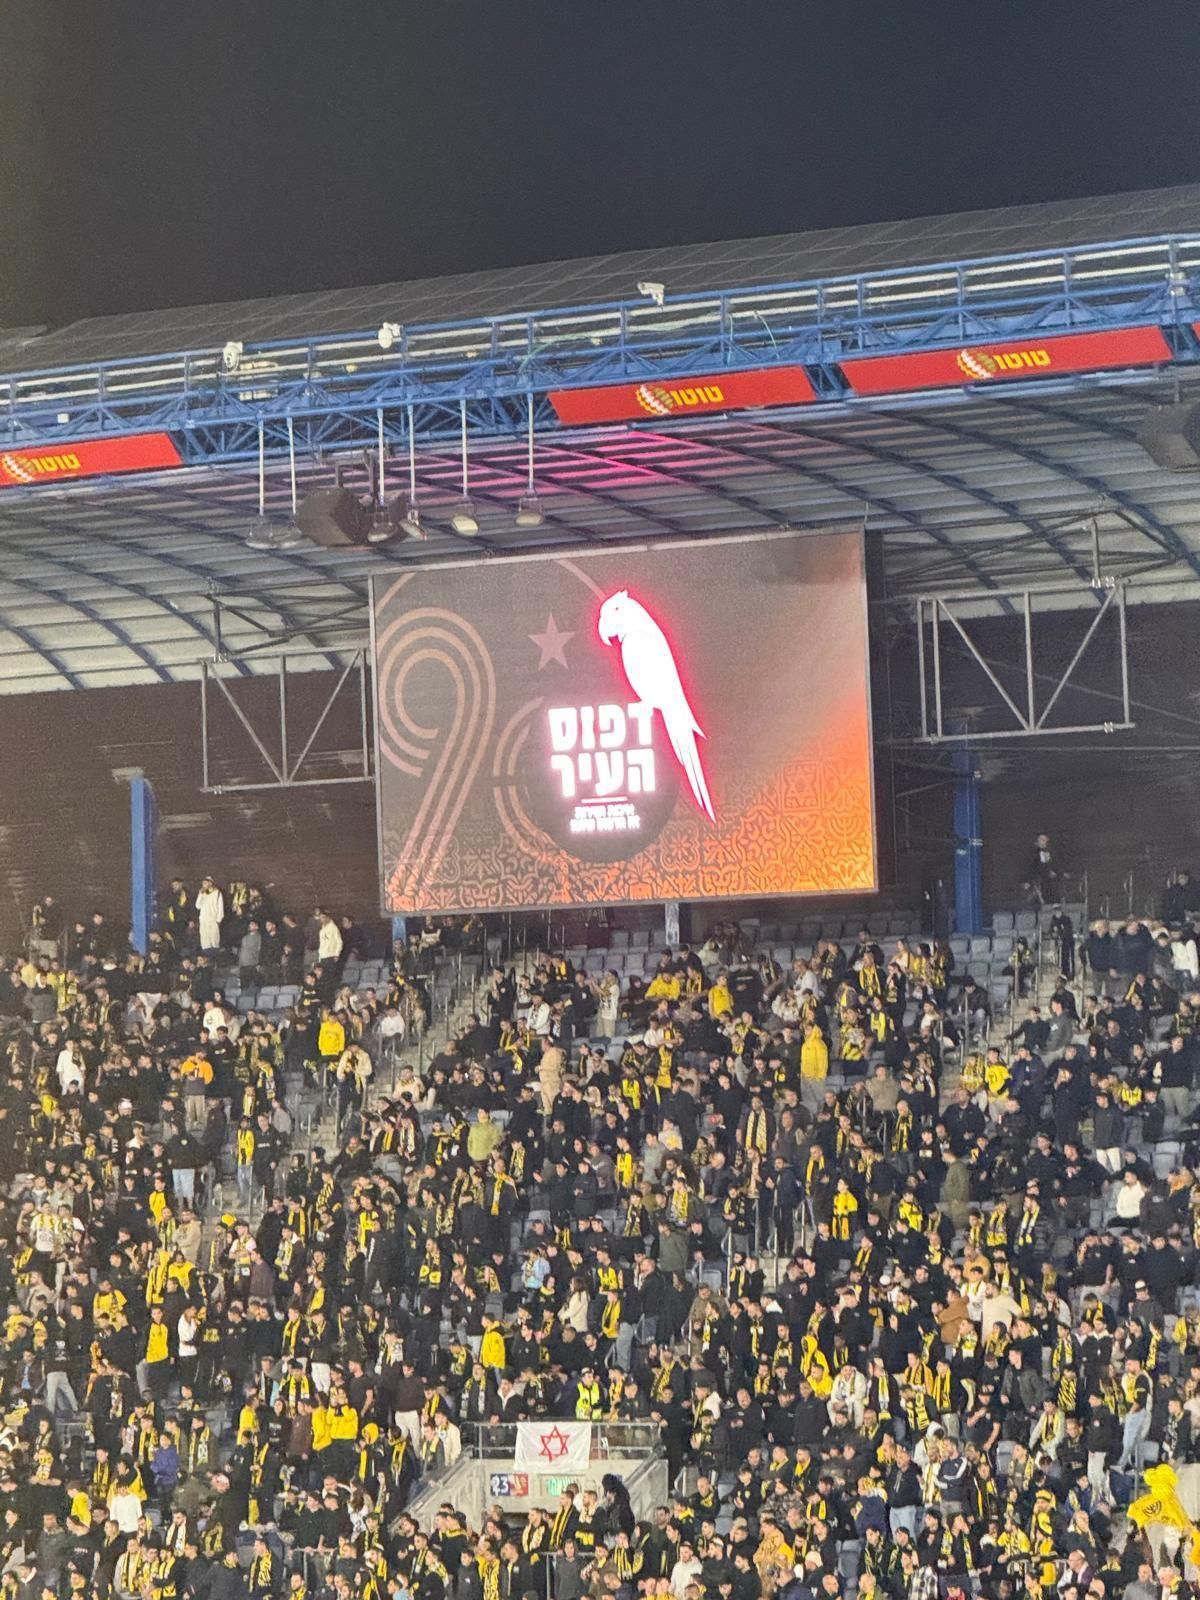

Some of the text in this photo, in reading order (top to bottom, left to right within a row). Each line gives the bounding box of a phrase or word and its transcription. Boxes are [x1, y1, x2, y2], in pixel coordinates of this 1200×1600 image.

[994, 350, 1051, 370] טוטו
[670, 385, 724, 407] טוטו
[31, 453, 81, 473] טוטו
[548, 702, 653, 751] דפוס
[551, 748, 656, 797] העיר
